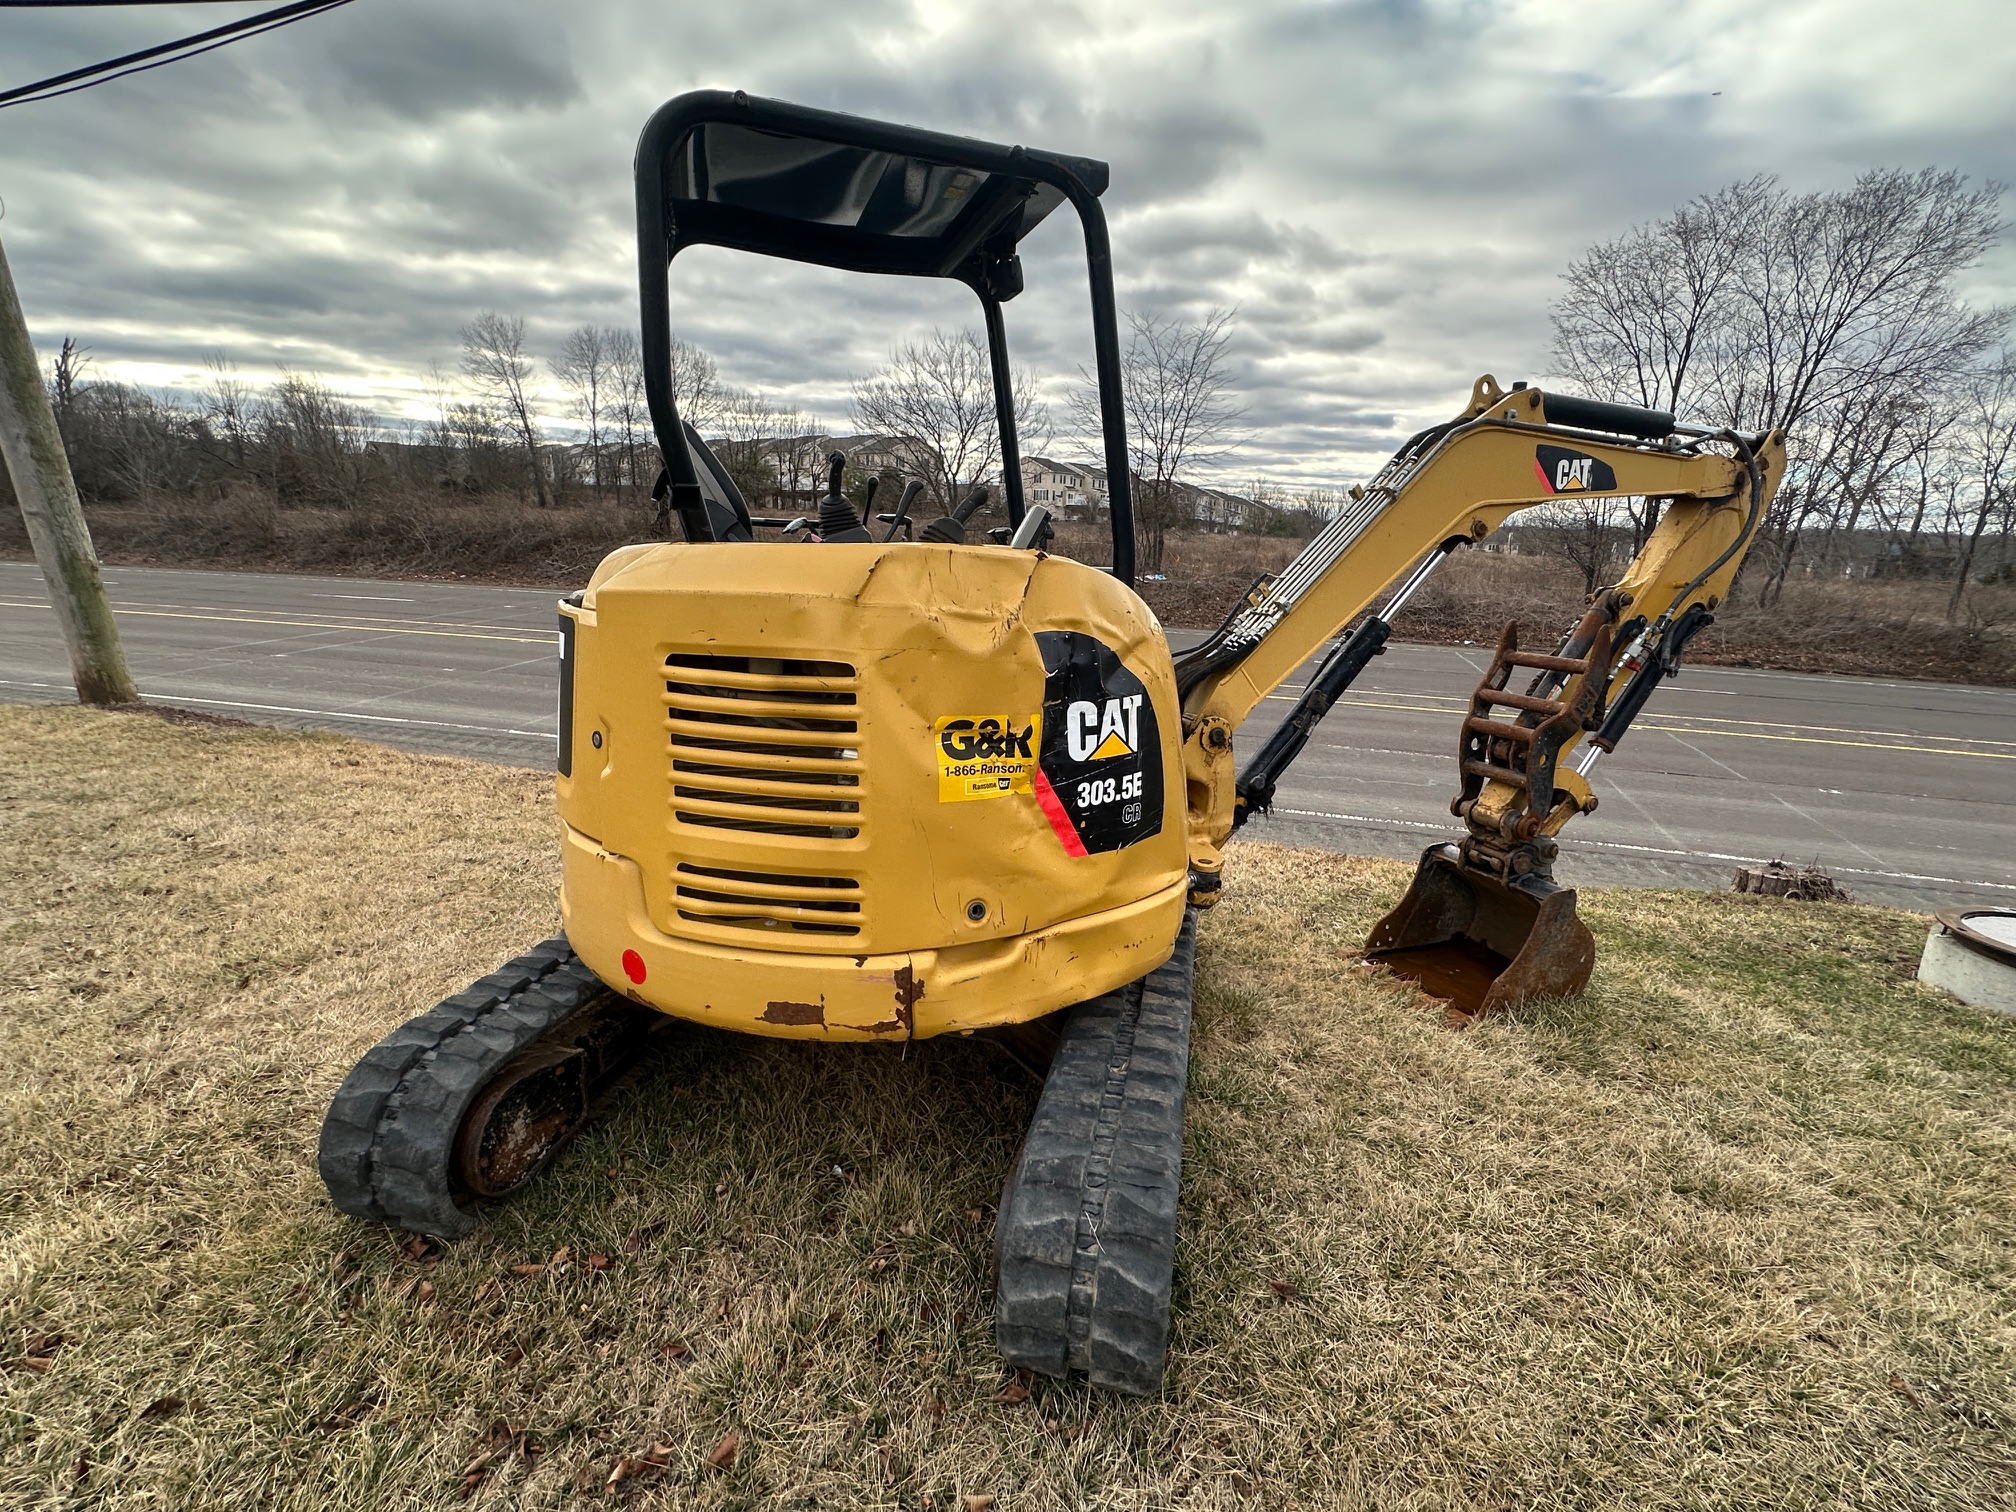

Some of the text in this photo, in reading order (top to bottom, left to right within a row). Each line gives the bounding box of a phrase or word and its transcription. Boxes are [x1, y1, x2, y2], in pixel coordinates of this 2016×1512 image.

[1556, 459, 1593, 490] CAT
[942, 719, 1033, 760] G&K
[1067, 694, 1142, 761] CAT
[1077, 771, 1142, 808] 303.5E
[1122, 802, 1141, 823] CR
